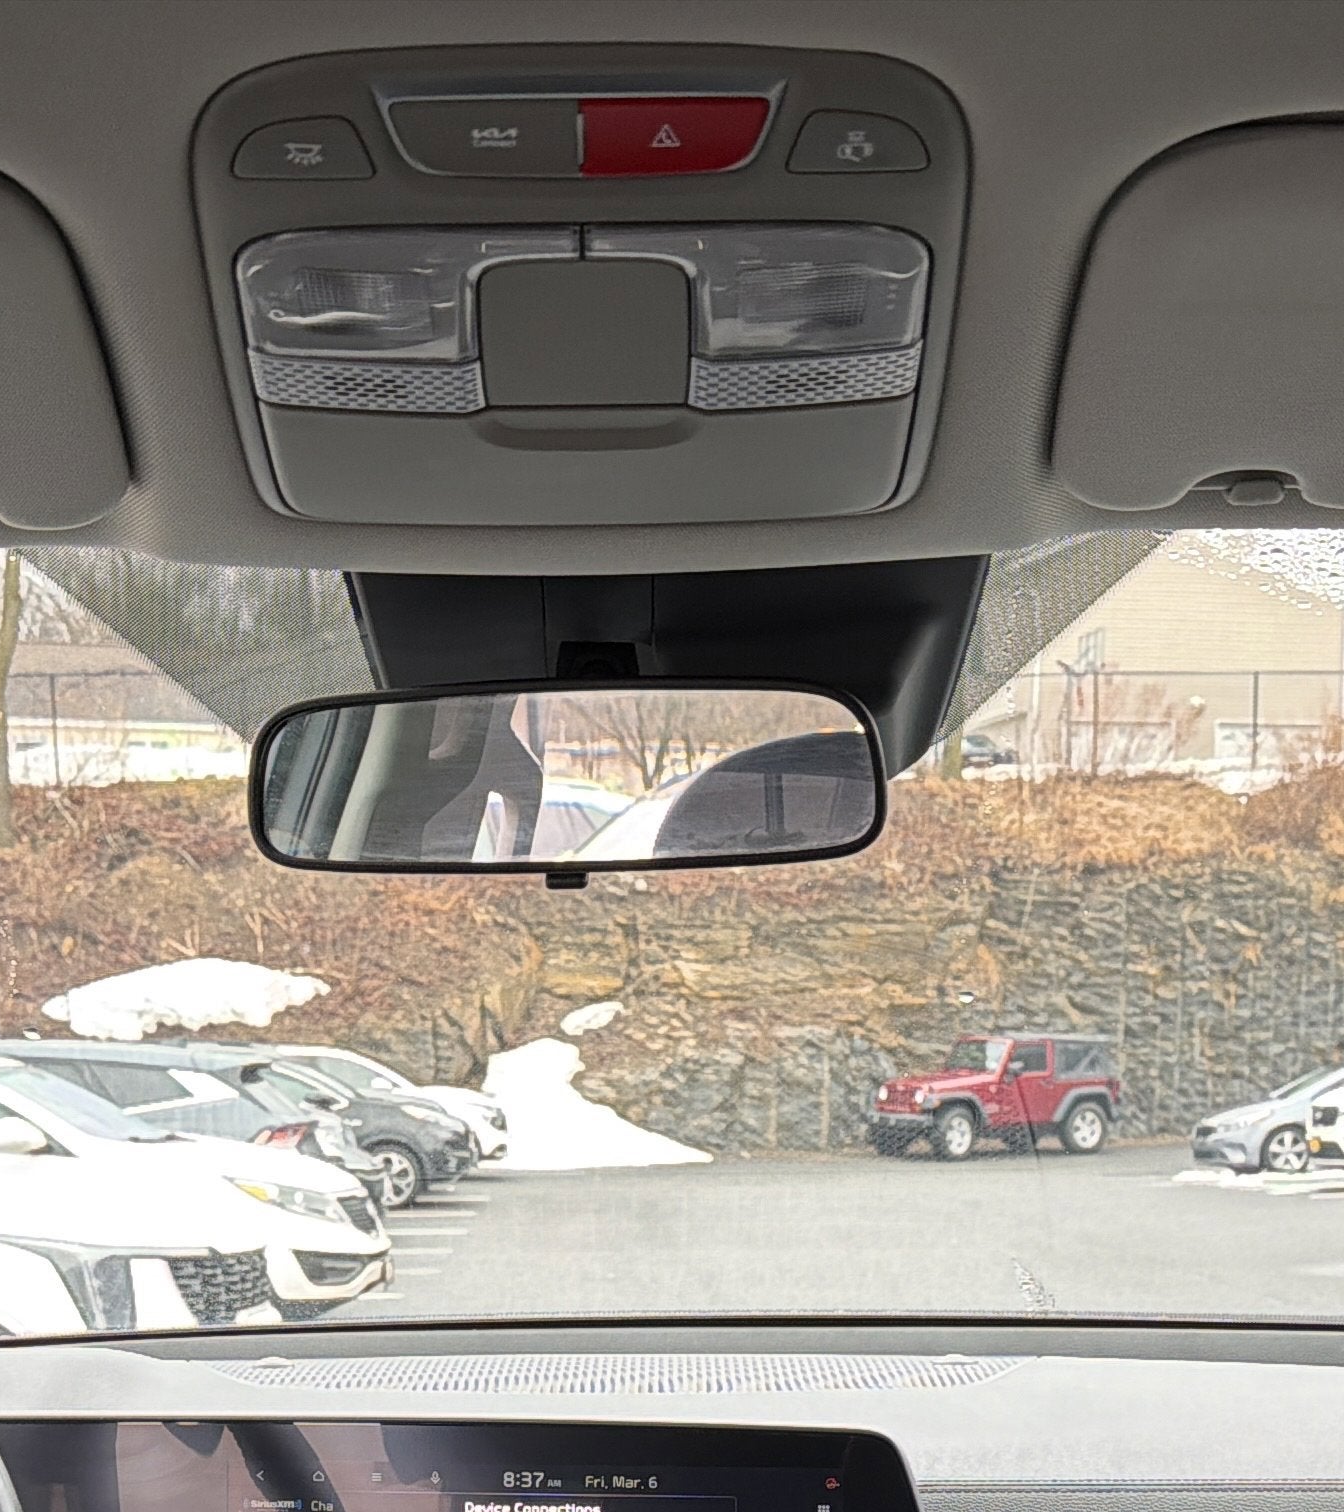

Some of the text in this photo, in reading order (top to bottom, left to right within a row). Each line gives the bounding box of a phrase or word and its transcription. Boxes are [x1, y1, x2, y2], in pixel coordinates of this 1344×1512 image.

[502, 1471, 545, 1488] 8:37
[613, 1476, 645, 1489] Mar.
[648, 1477, 659, 1489] 6
